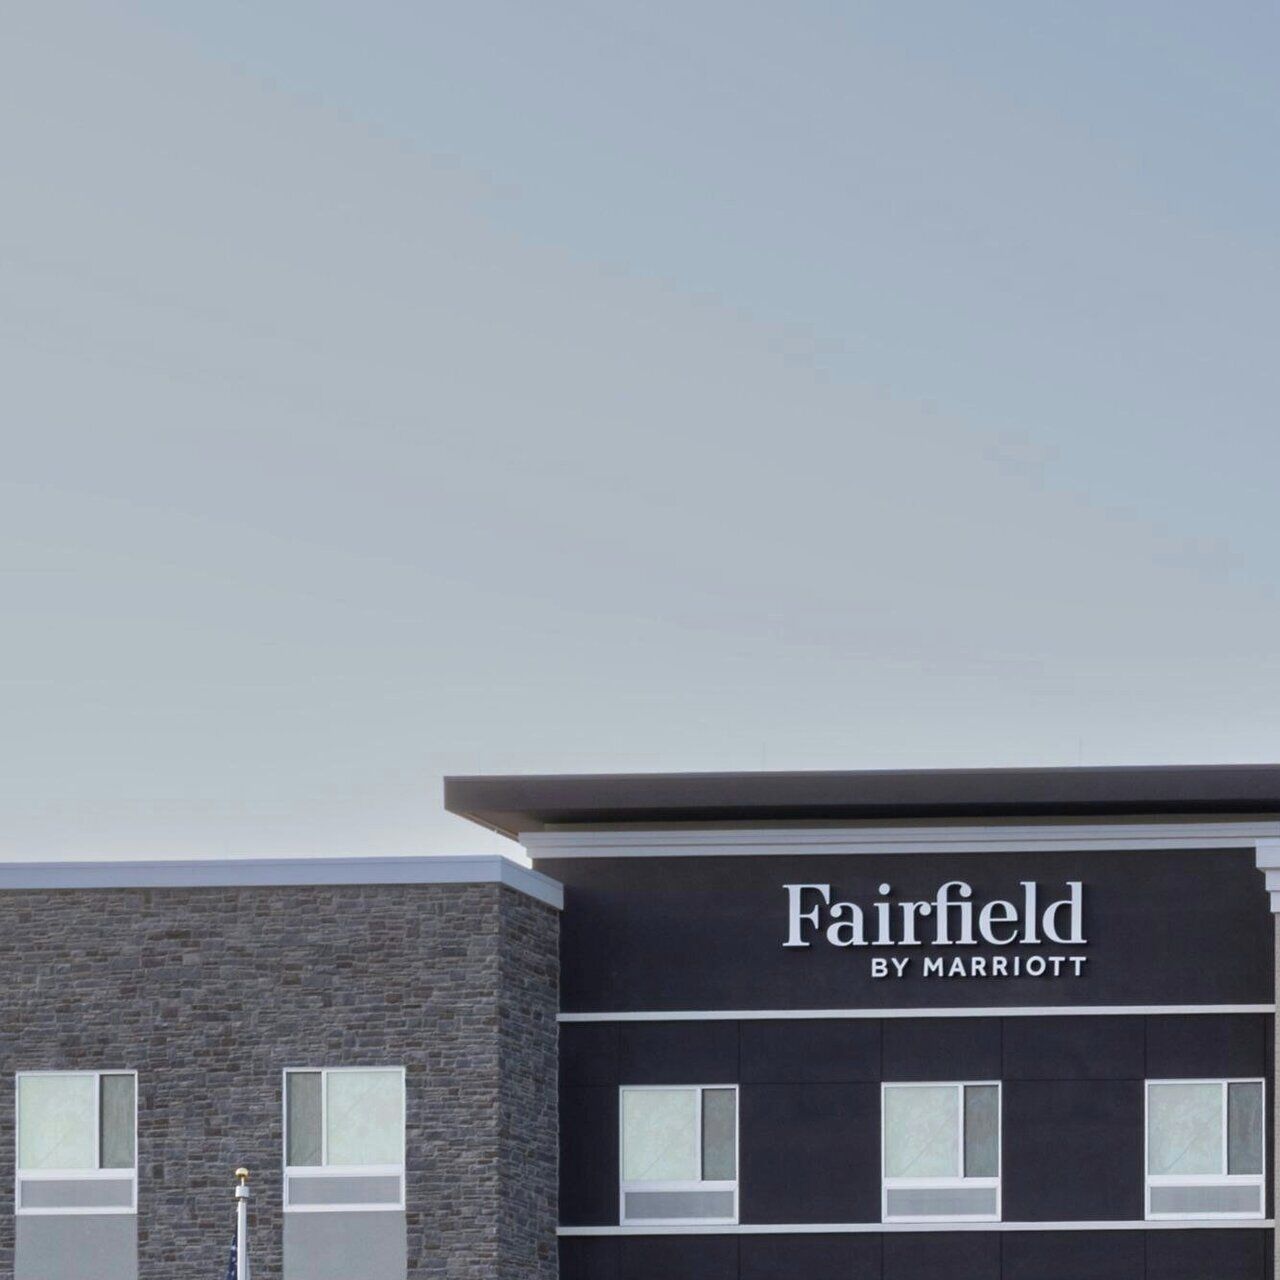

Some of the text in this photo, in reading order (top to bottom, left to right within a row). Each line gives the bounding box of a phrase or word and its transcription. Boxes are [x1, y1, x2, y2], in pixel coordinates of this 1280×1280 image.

[782, 880, 1088, 947] Fairfield
[871, 955, 1087, 978] BY MARRIOTT
